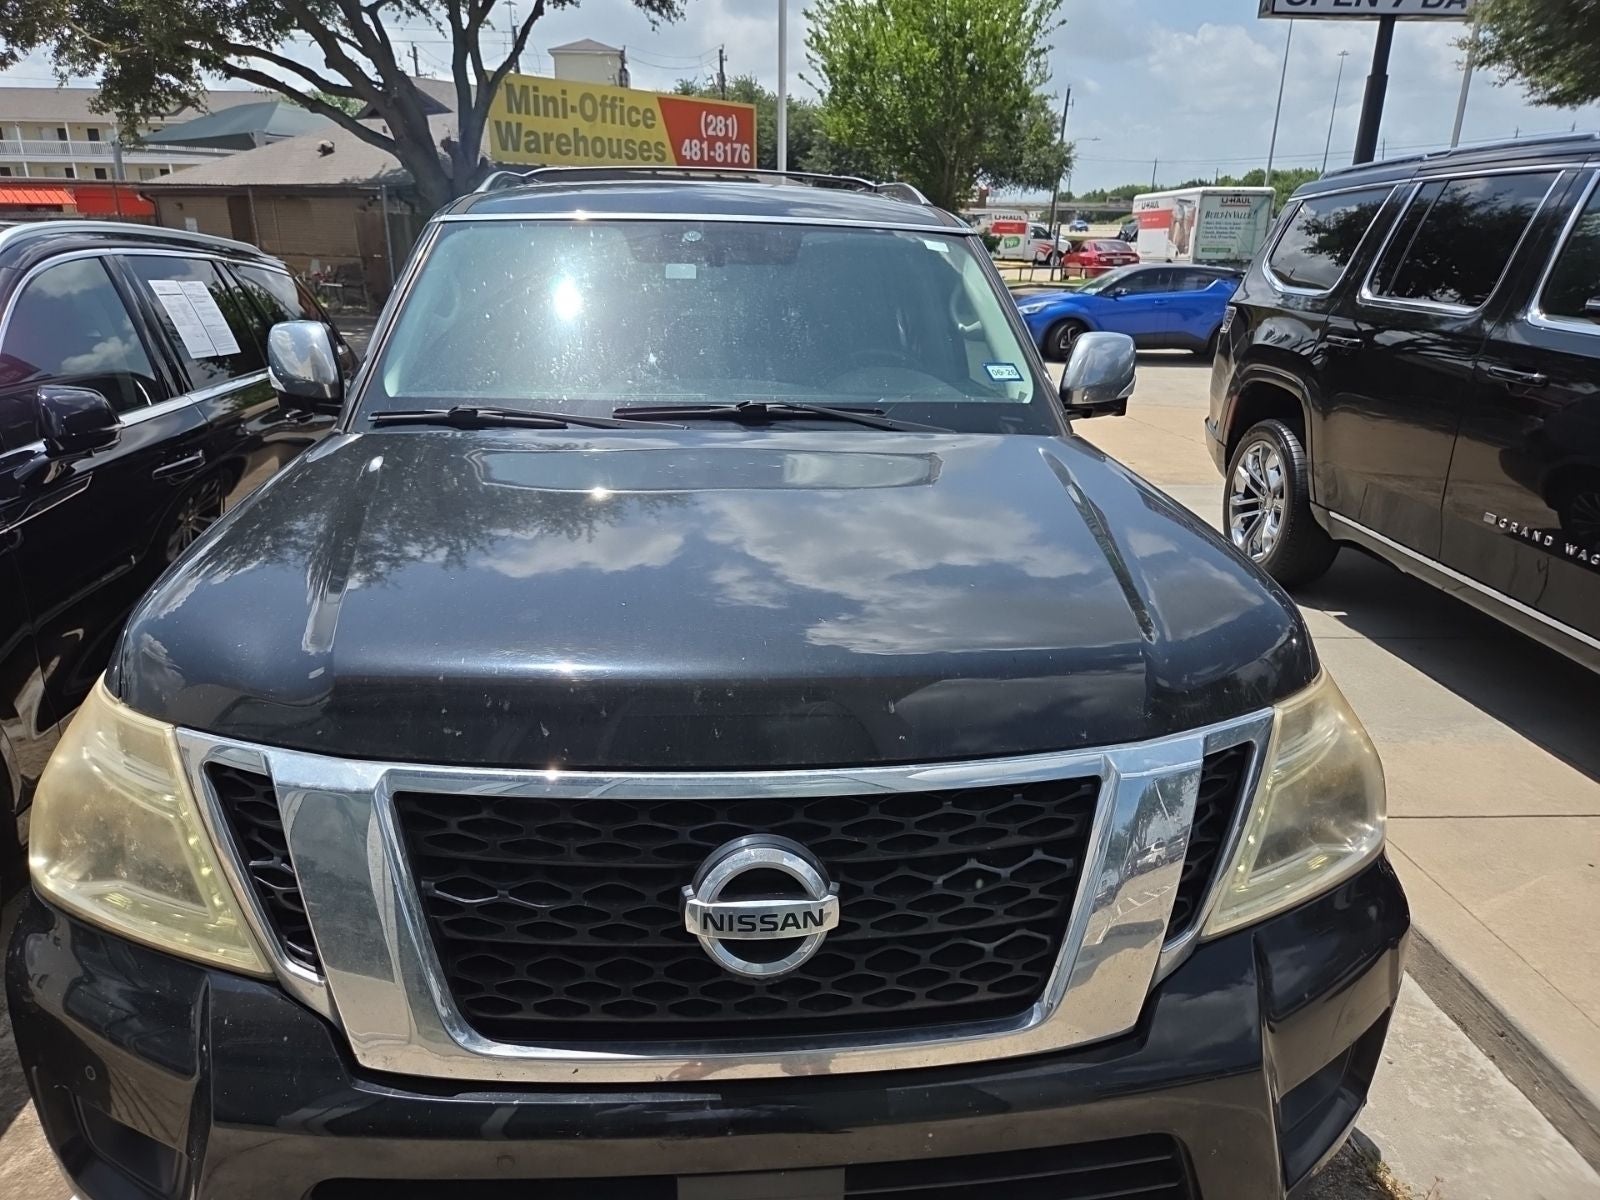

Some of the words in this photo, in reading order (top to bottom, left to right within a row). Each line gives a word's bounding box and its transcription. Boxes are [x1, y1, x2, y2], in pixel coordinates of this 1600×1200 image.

[505, 83, 656, 129] Mini-Office
[495, 120, 667, 163] Warehouses
[701, 111, 738, 140] (281)
[681, 138, 750, 164] 481-8176
[1499, 518, 1553, 546] GRAND
[1565, 542, 1600, 565] WAG
[703, 908, 824, 933] NISSAN
